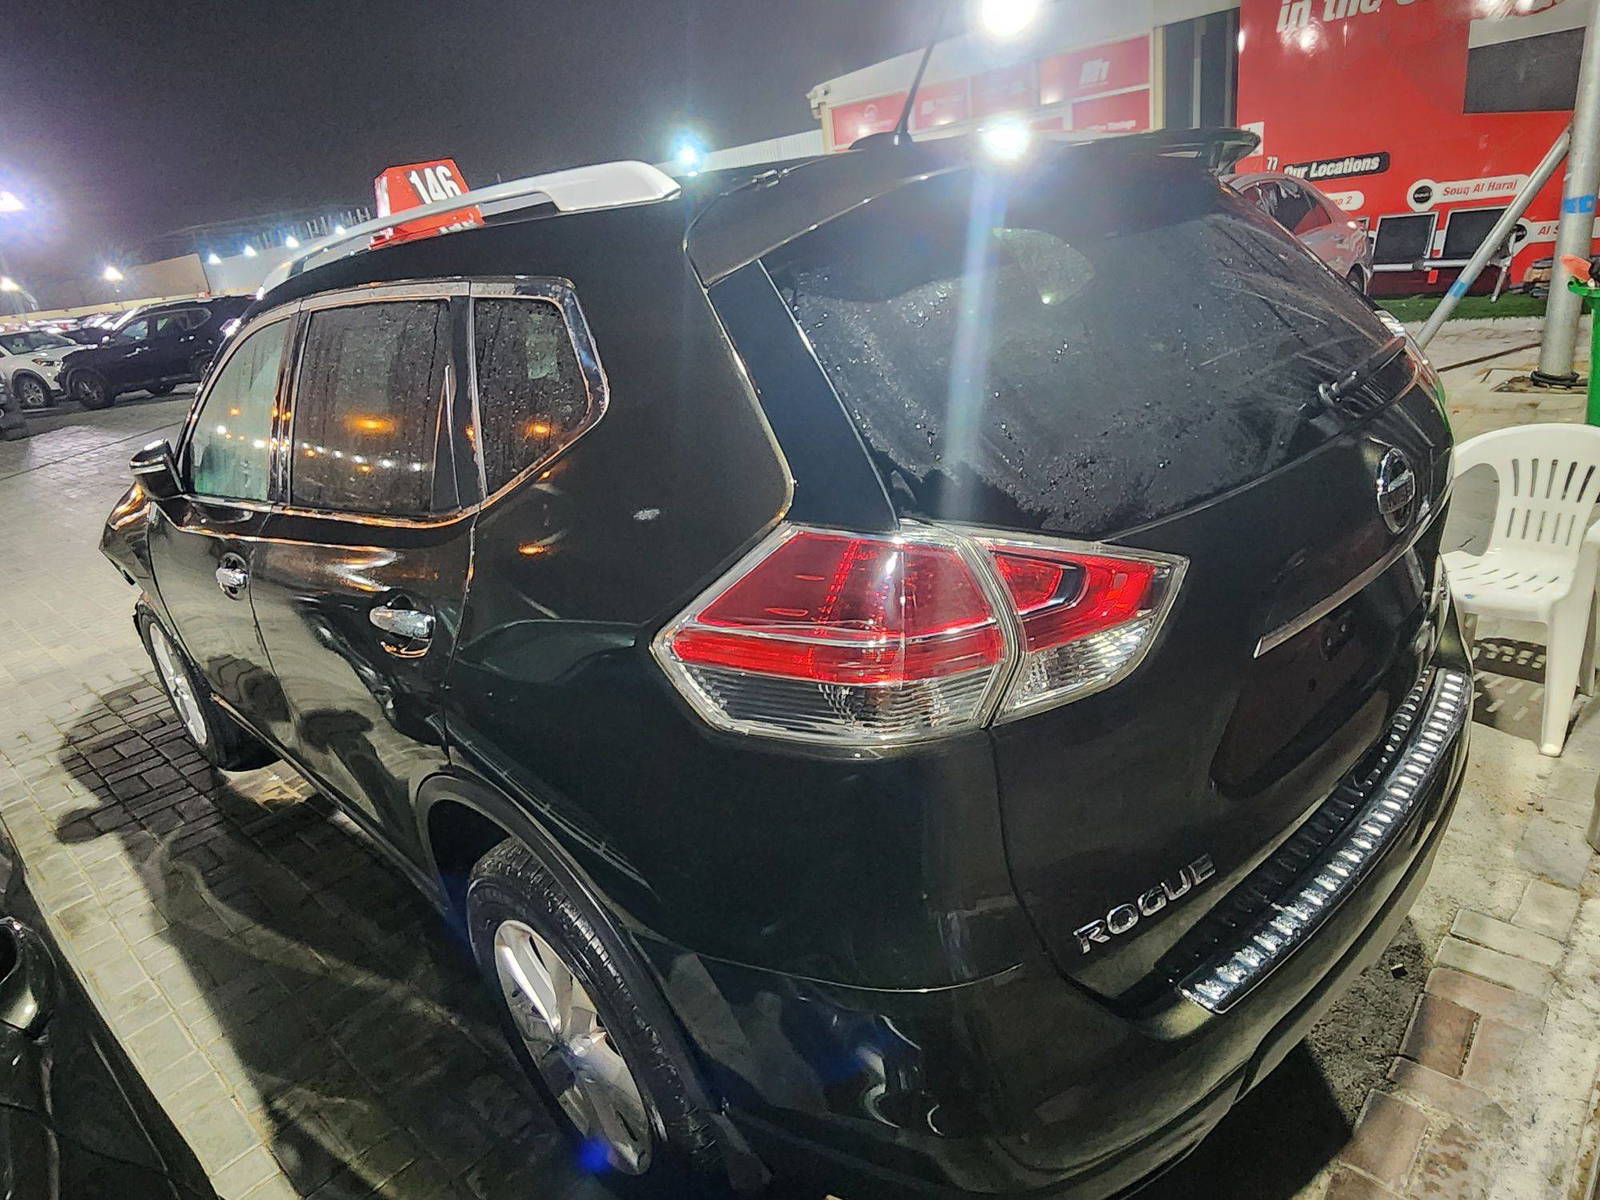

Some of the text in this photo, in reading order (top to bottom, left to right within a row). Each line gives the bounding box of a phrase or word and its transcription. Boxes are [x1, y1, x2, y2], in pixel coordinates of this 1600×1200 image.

[1283, 156, 1380, 179] Our Locations
[409, 165, 462, 205] 146
[1443, 186, 1470, 196] Souq
[1473, 183, 1485, 194] Al
[1487, 180, 1518, 192] Haraj
[1072, 852, 1216, 955] ROGUE
